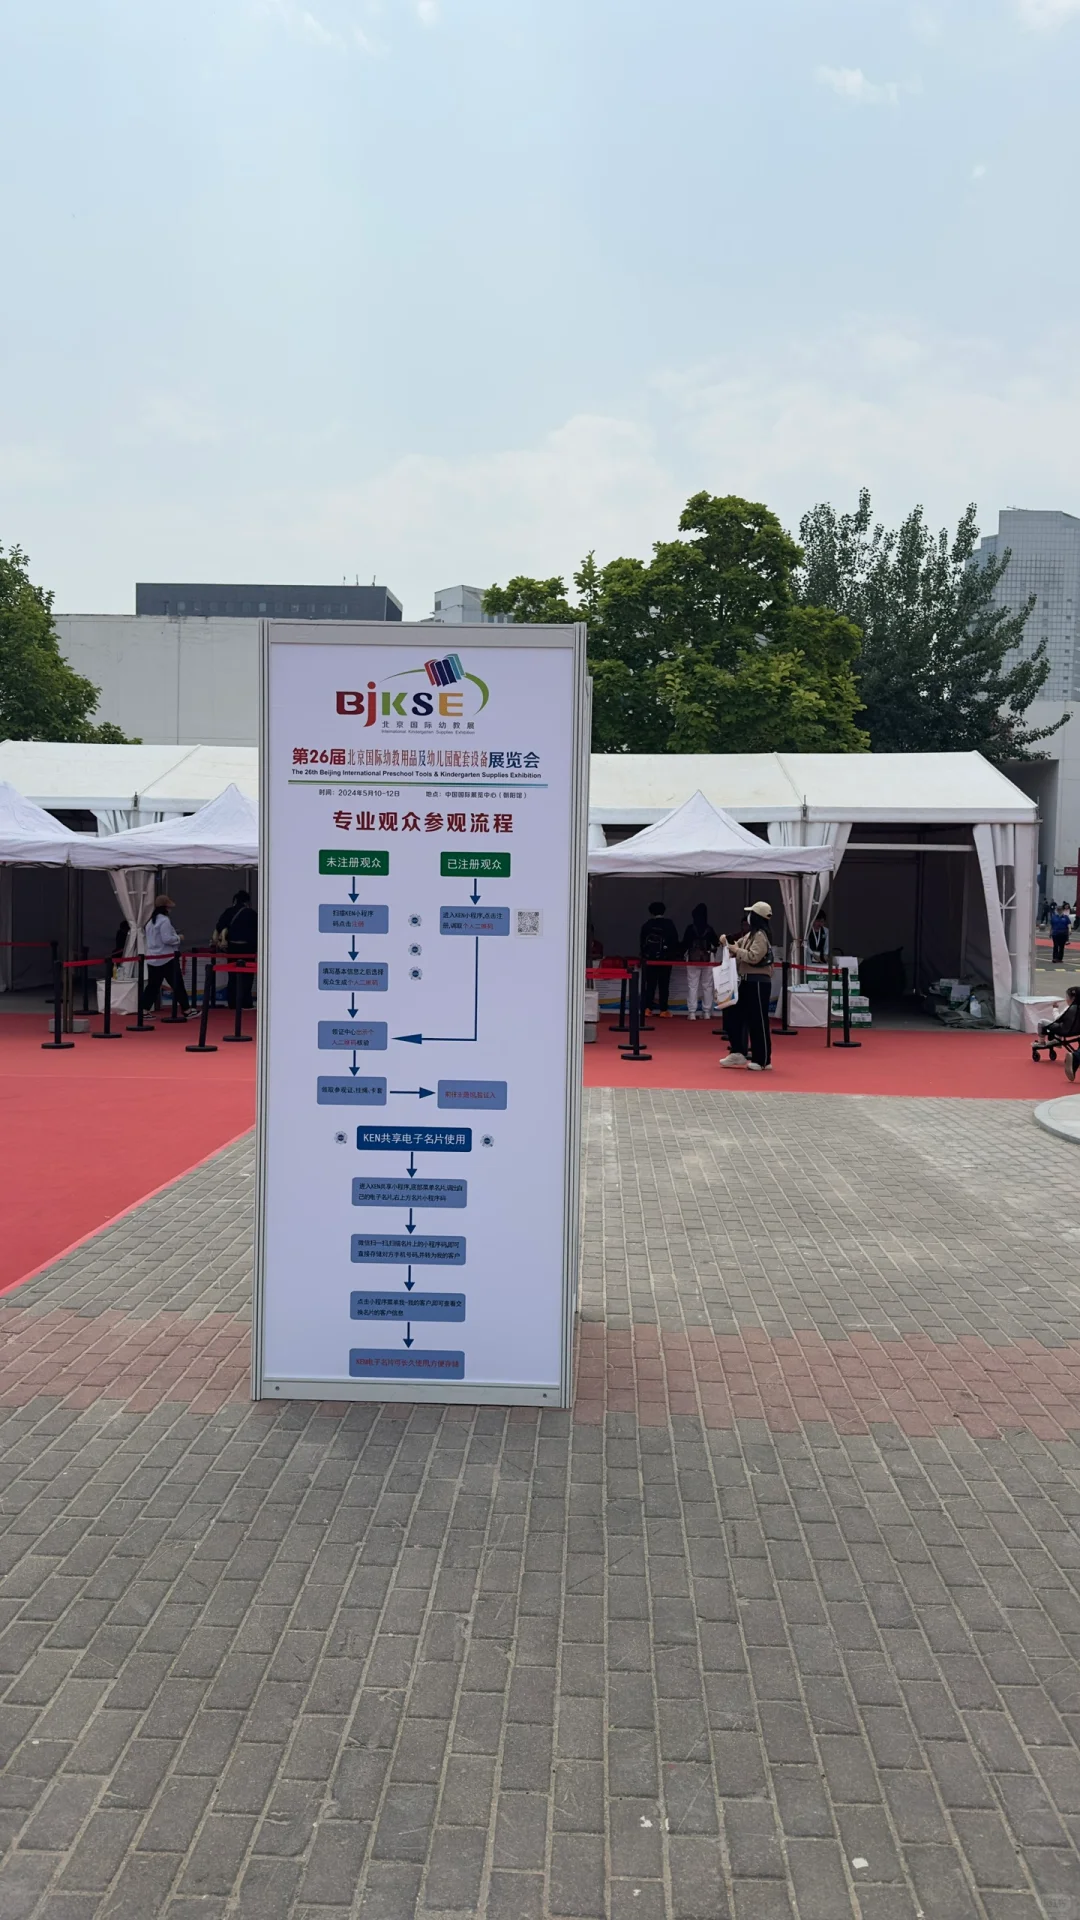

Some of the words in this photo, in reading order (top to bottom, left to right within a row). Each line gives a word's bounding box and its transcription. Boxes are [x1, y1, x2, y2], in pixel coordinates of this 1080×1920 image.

[381, 720, 475, 730] 北京国际幼教展
[292, 747, 541, 769] 第26届北京国际幼教用品及幼儿园配套设备展览会
[319, 769, 341, 777] Beijing
[332, 811, 514, 833] 专业观众参观流程
[326, 856, 382, 868] 未注册观众
[447, 859, 502, 870] 已注册观众
[363, 1133, 466, 1145] KEN共享电子名片使用
